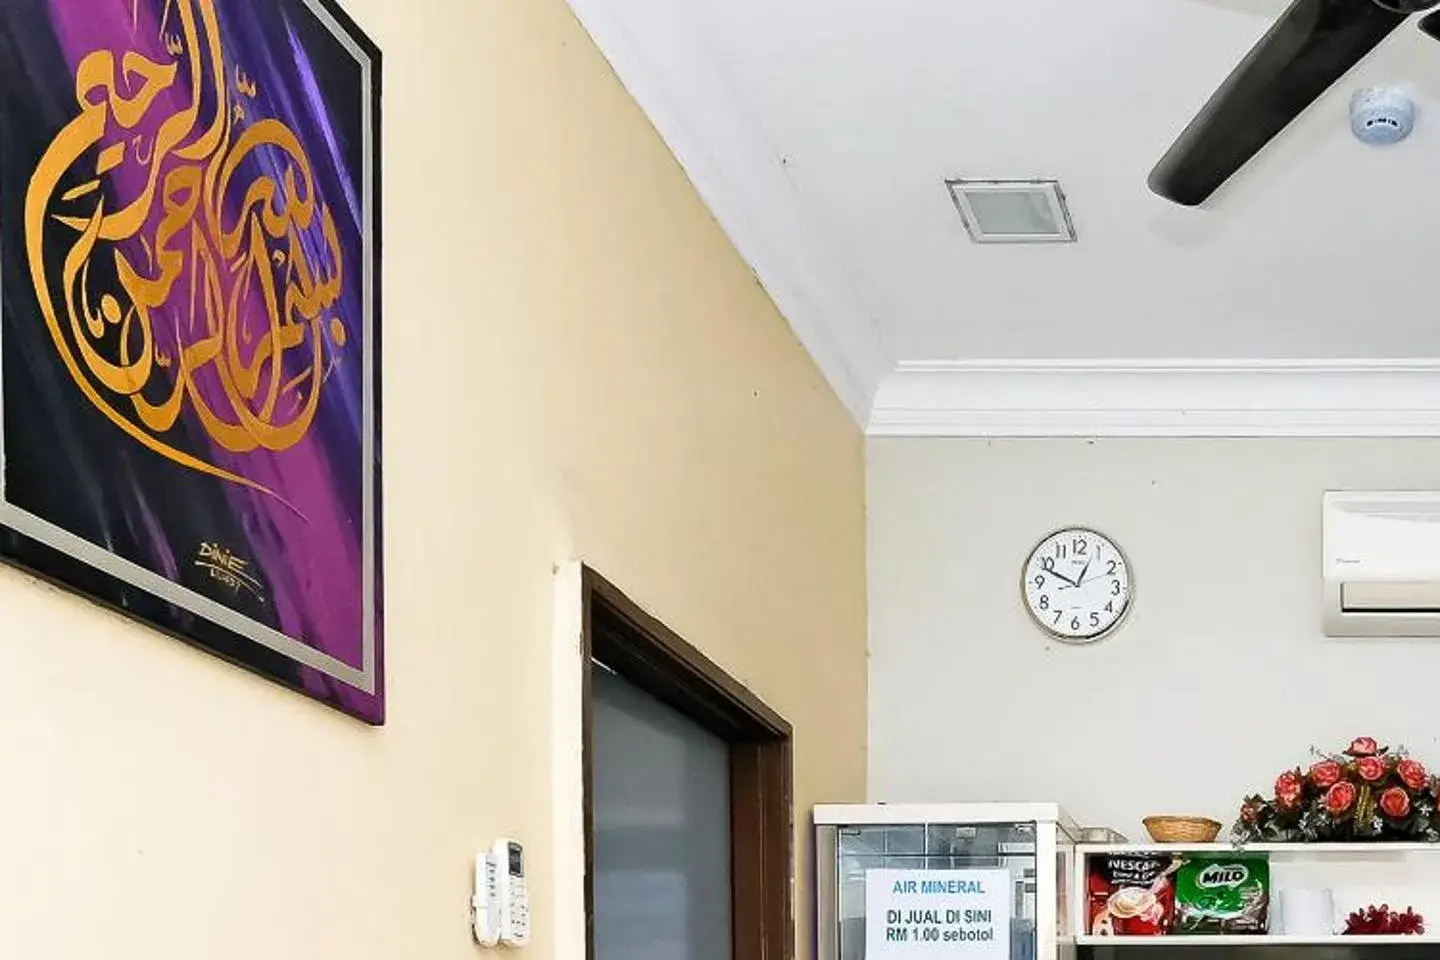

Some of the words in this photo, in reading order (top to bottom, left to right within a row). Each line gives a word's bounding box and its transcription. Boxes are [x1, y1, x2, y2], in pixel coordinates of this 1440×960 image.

[1055, 541, 1067, 559] 11
[1072, 539, 1087, 556] 12
[1096, 544, 1101, 560] 1
[1106, 560, 1117, 576] 2
[1034, 575, 1045, 589] 9
[1111, 579, 1120, 596] 3
[1040, 594, 1049, 610] 8
[1104, 600, 1113, 613] 4
[1053, 610, 1063, 625] 7
[1071, 616, 1080, 630] 6
[1090, 611, 1099, 627] 5
[1202, 870, 1243, 884] MILO
[892, 880, 917, 894] AIR
[921, 880, 986, 894] MINERAL
[887, 909, 902, 924] DI
[906, 909, 942, 924] JUAL
[946, 909, 960, 924] DI
[964, 909, 992, 924] SINI
[886, 926, 907, 942] RM
[912, 926, 940, 942] 1.00
[943, 925, 994, 942] sebotol
